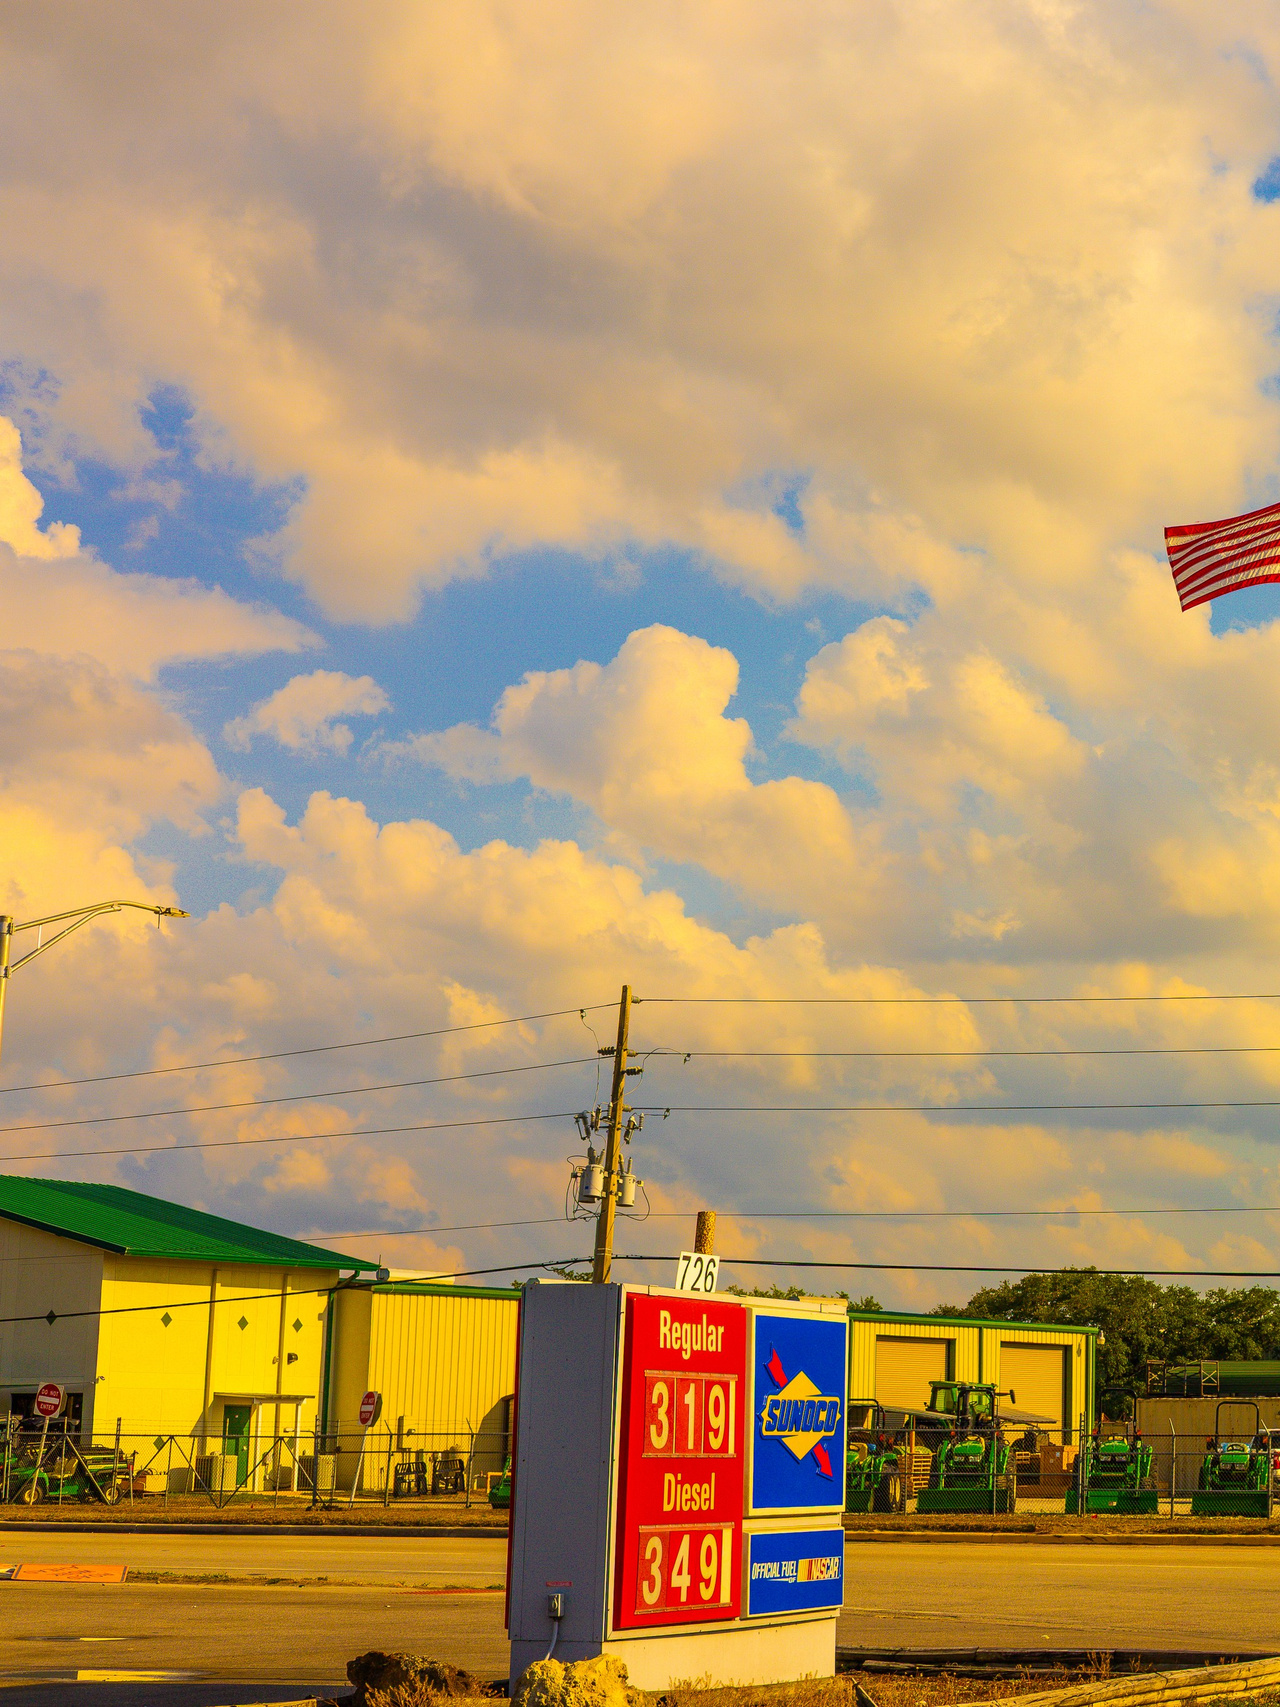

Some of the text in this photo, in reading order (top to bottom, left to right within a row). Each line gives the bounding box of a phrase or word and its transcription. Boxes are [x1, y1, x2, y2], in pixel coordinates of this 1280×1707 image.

[680, 1255, 716, 1292] 726
[660, 1310, 724, 1360] Regular
[40, 1403, 55, 1411] ENTER
[650, 1381, 726, 1450] 319
[765, 1399, 839, 1432] SUNOCO
[663, 1472, 716, 1512] Diesel
[642, 1533, 718, 1605] 349
[752, 1557, 840, 1580] OFFICIAL FUEL NASCAR
